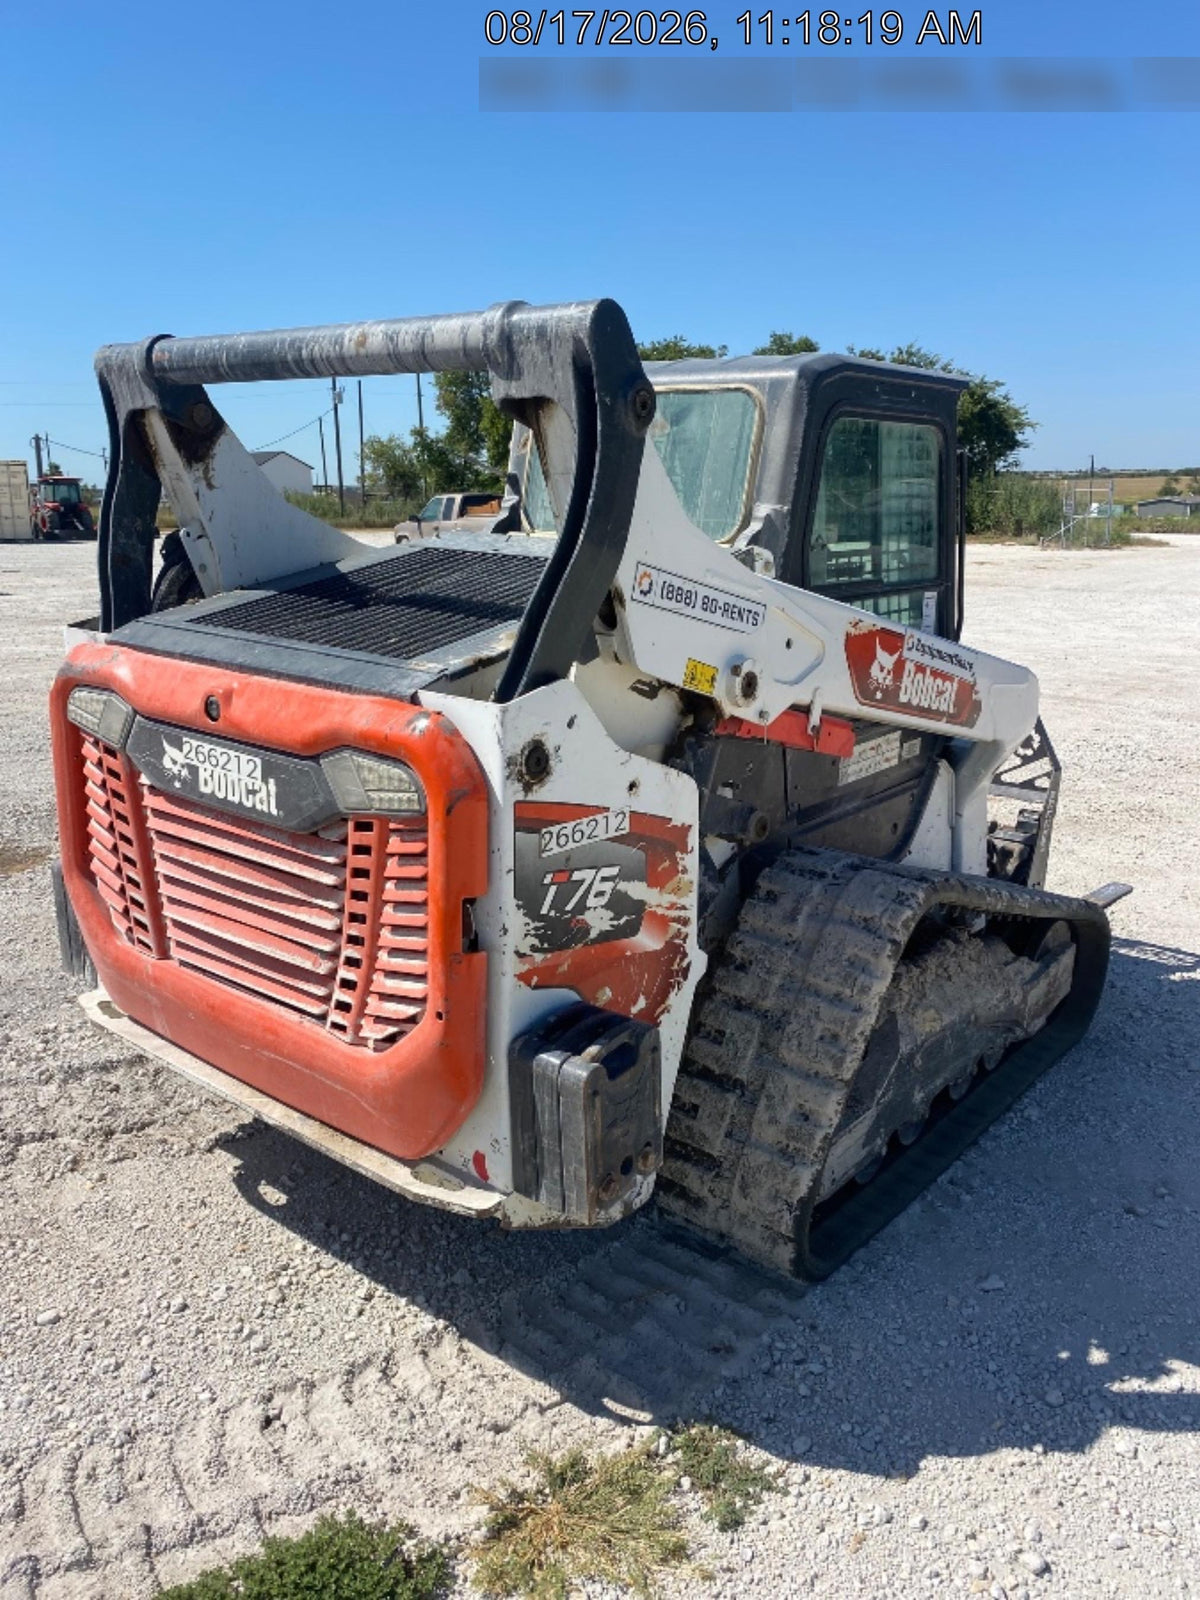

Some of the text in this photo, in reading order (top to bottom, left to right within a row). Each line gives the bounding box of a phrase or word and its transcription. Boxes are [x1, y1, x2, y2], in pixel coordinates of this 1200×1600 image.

[660, 580, 698, 609] (888)
[899, 659, 958, 713] Bobcat
[183, 740, 259, 780] 266212
[541, 811, 627, 852] 266212
